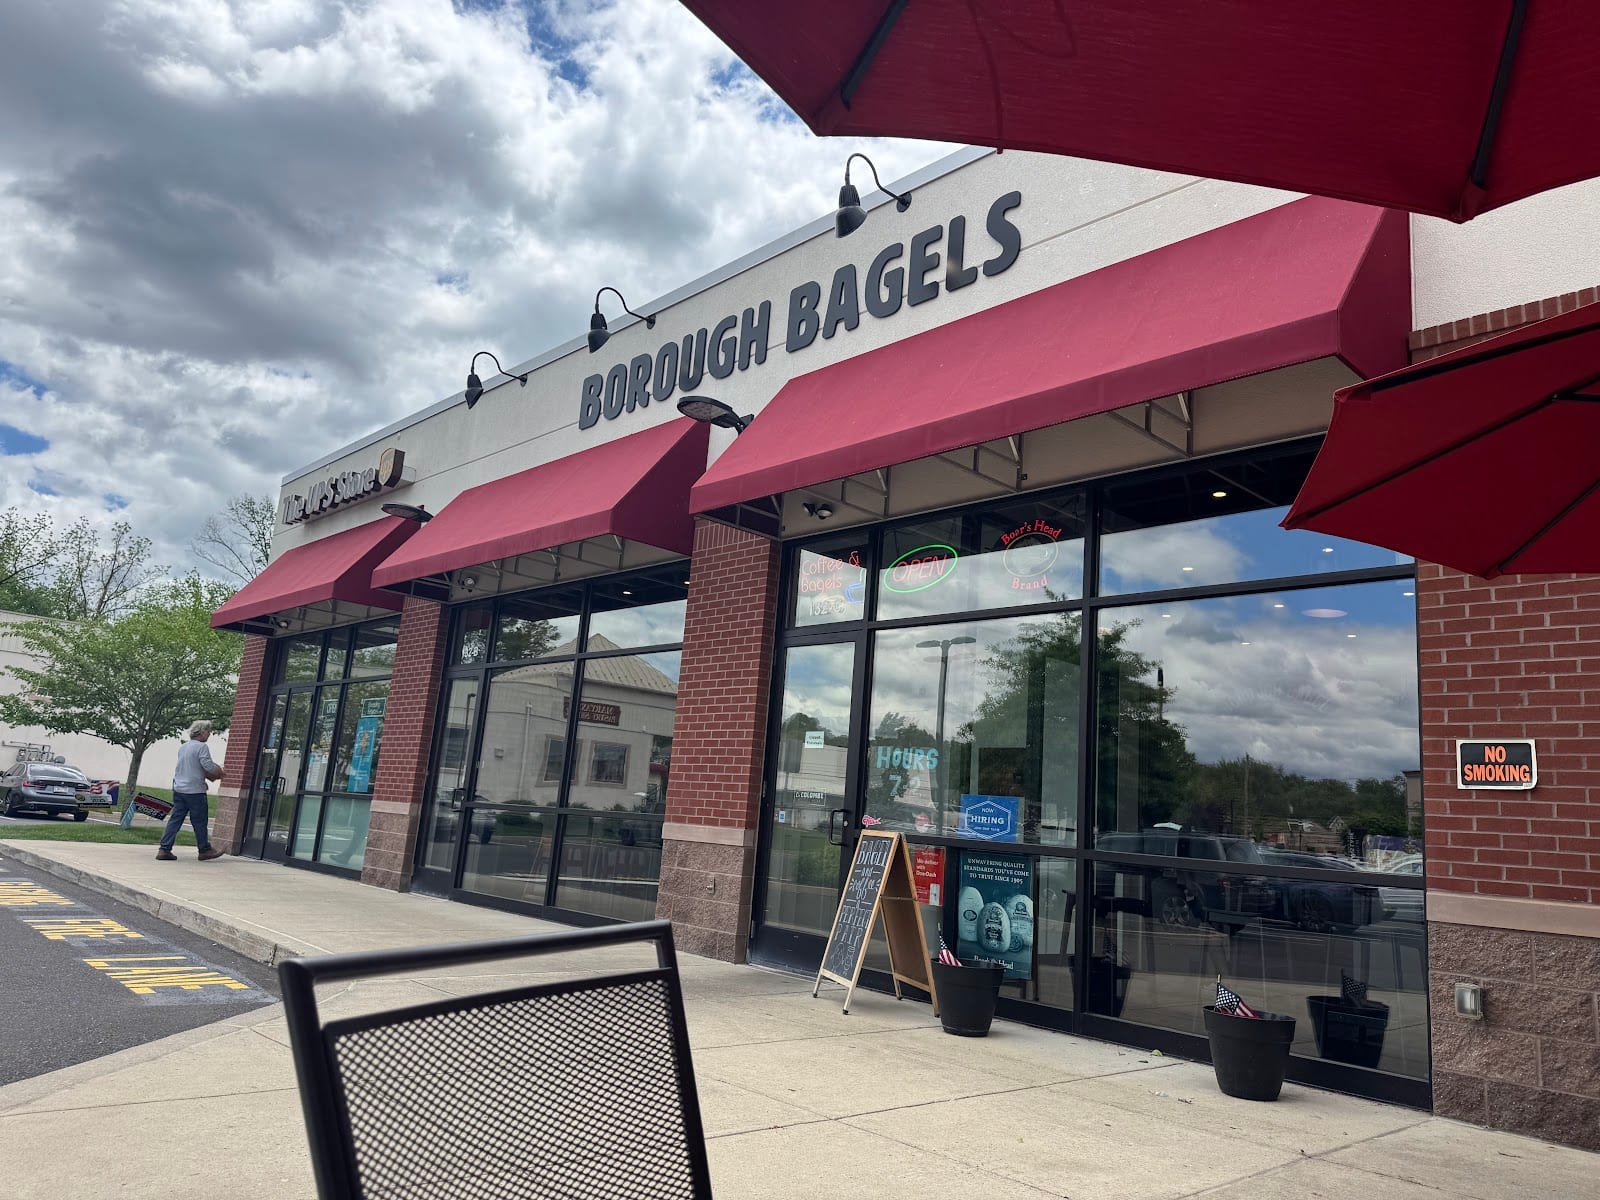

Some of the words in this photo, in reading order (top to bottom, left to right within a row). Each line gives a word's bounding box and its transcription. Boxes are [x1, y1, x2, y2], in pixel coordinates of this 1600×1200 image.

[579, 300, 771, 430] BOROUGH
[786, 190, 1022, 353] BAGELS
[282, 494, 305, 524] The
[305, 477, 335, 514] UPS
[335, 467, 376, 503] Store
[1001, 521, 1032, 545] Boar's
[1034, 520, 1062, 539] Head
[802, 557, 844, 576] Coffee
[848, 550, 860, 567] &
[892, 554, 948, 583] OPEN
[1011, 575, 1049, 590] Brand
[877, 746, 939, 770] HOURS
[1484, 745, 1507, 763] NO
[1464, 764, 1531, 782] SMOKING
[971, 815, 1005, 825] HIRING
[964, 865, 994, 873] STANDARDS
[968, 858, 1002, 867] UNWAVERING
[1003, 861, 1025, 869] QUALITY
[978, 873, 994, 881] TRUST
[23, 919, 145, 940] FIRE
[82, 956, 249, 994] LANE
